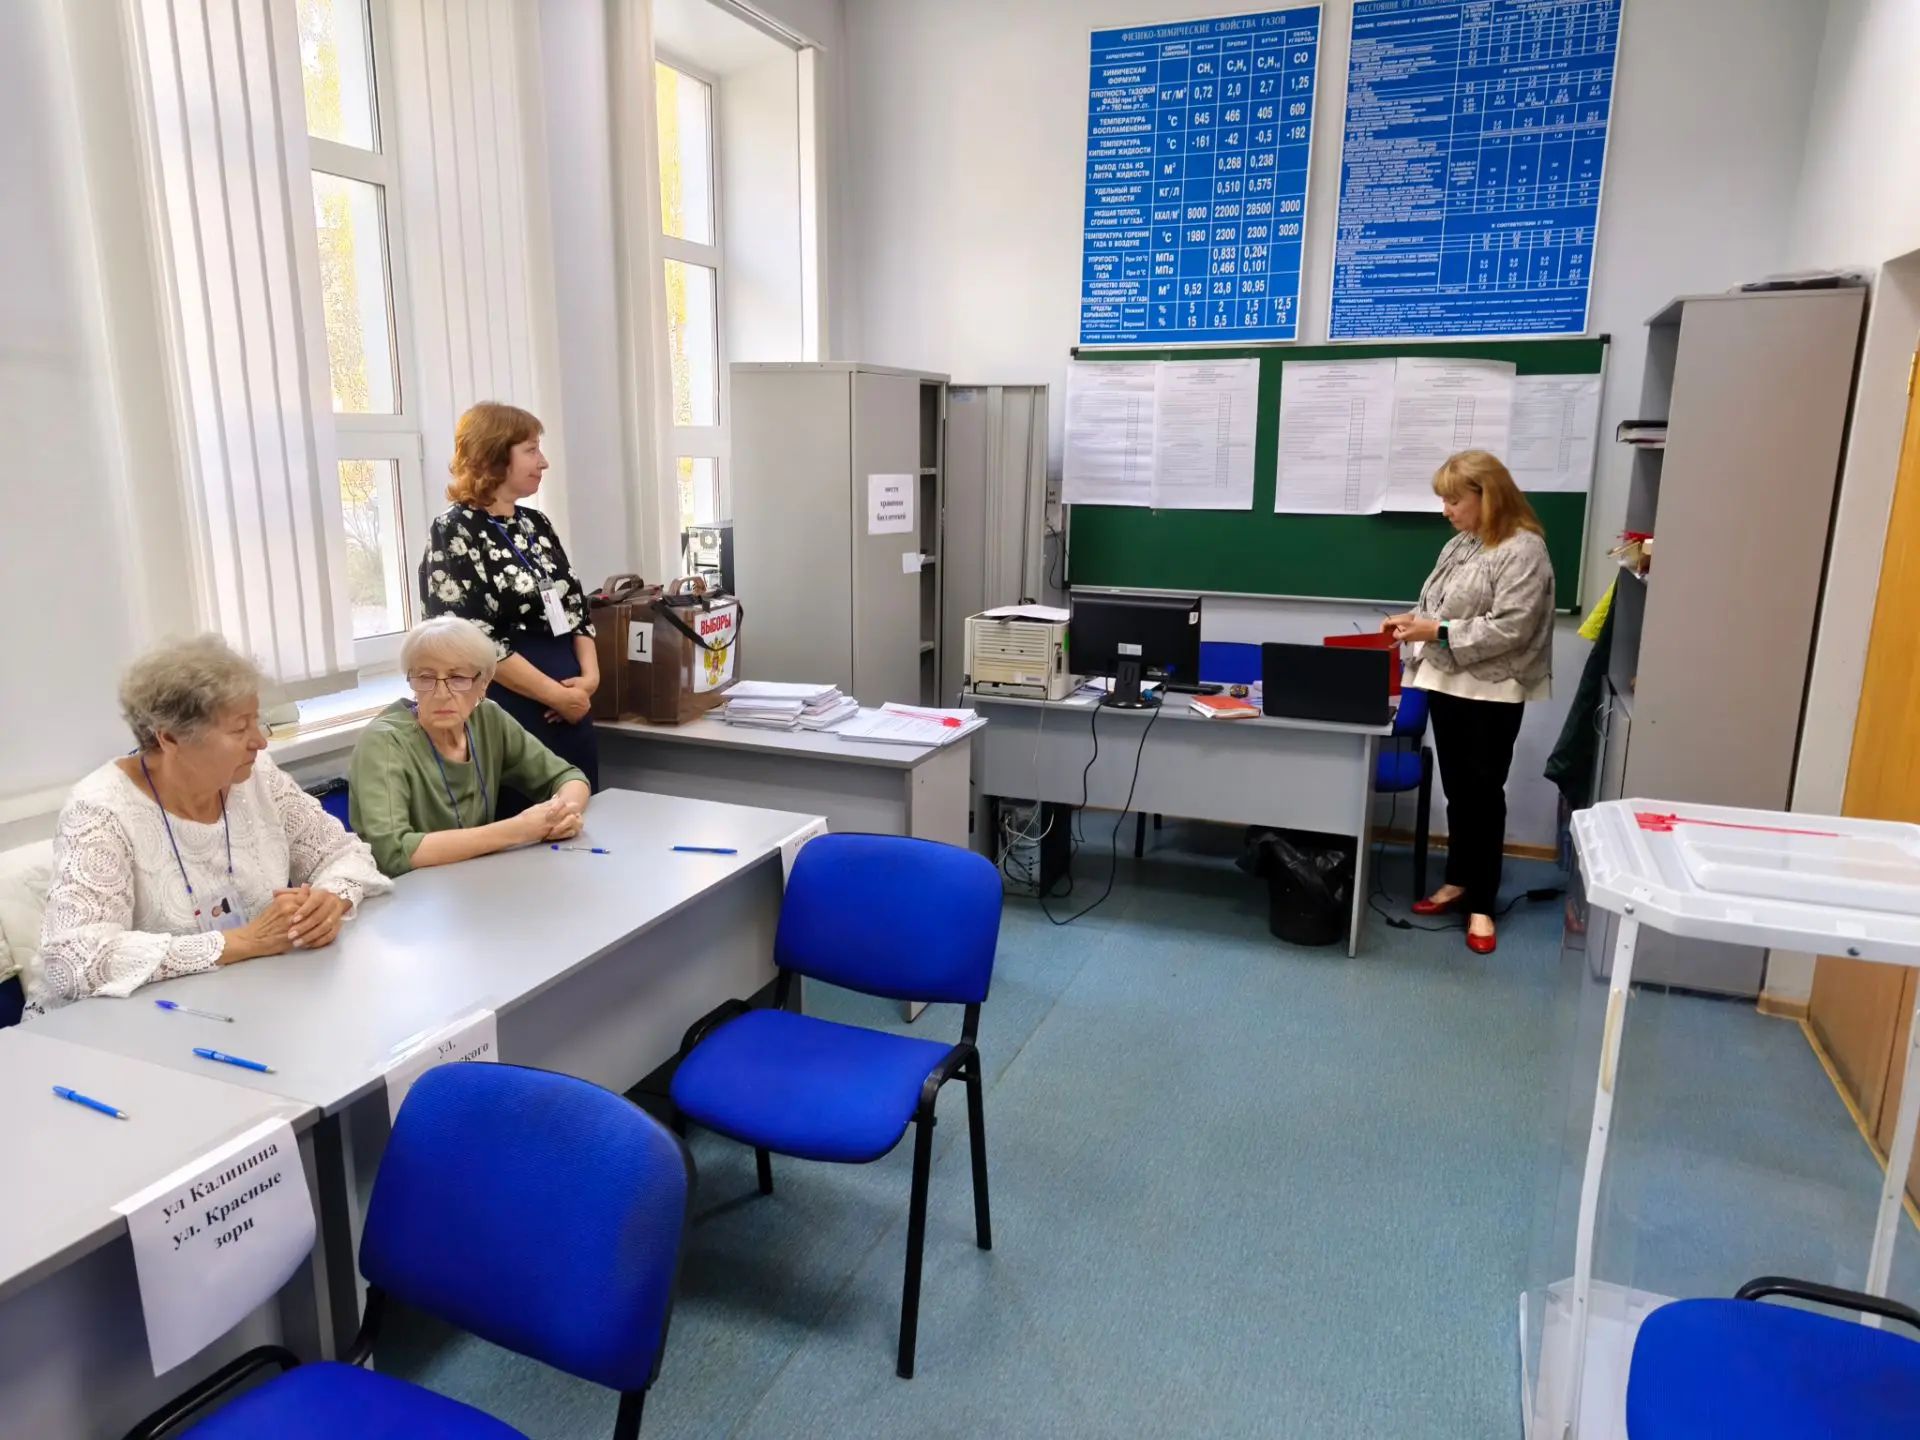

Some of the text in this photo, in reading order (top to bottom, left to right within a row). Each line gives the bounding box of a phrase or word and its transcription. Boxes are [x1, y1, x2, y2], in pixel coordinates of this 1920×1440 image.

[1121, 15, 1287, 42] ФИЗИКО-ХИМИЧЕСКИЕ СВОЙСТВА ГАЗОВ
[1103, 66, 1147, 77] ХИМИЧЕСКАЯ
[1108, 75, 1141, 85] ФОРМУЛА
[1291, 76, 1309, 91] 1,25
[1091, 86, 1156, 98] ПЛОТНОСТЬ ГАЗОВОЙ
[1194, 85, 1213, 101] 0,72
[1227, 82, 1241, 98] 2,0
[1260, 80, 1274, 94] 2,7
[1257, 106, 1273, 119] 405
[1290, 102, 1306, 116] 609
[1100, 116, 1146, 126] ТЕМПЕРАТУРА
[1194, 112, 1210, 125] 645
[1093, 124, 1152, 135] ВОСПЛАМЕНЕНИЯ
[1286, 126, 1306, 140] -192
[1100, 138, 1140, 148] ТЕМПЕРАТУРА
[1191, 135, 1210, 148] -161
[1225, 132, 1239, 145] -42
[1255, 130, 1272, 144] -0,5
[1088, 147, 1151, 157] КИПЕНИЯ ЖИДКОСТИ
[1218, 156, 1241, 171] 0,268
[1250, 154, 1274, 168] 0,238
[1116, 170, 1150, 179] ЖИДКОСТИ
[1094, 185, 1128, 195] УДЕЛЬНЫЙ
[1217, 180, 1240, 195] 0,510
[1248, 178, 1272, 192] 0,575
[1101, 195, 1135, 203] ЖИДКОСТИ
[1159, 187, 1180, 199] КГ/Л
[1187, 207, 1207, 219] 8000
[1215, 204, 1239, 218] 22000
[1246, 202, 1271, 215] 28500
[1280, 200, 1300, 213] 3000
[1187, 230, 1206, 242] 1980
[1216, 228, 1235, 241] 2300
[1247, 226, 1267, 239] 2300
[1279, 223, 1299, 236] 3020
[1155, 253, 1174, 262] МПа
[1213, 247, 1236, 260] 0,833
[1244, 245, 1267, 259] 0,204
[1155, 265, 1174, 275] МПа
[1243, 260, 1265, 274] 0,101
[1184, 283, 1202, 296] 9,52
[1213, 282, 1231, 295] 23,8
[1242, 280, 1265, 293] 30,95
[1190, 302, 1195, 313] 5
[1219, 301, 1224, 312] 2
[1246, 300, 1259, 312] 1,5
[1274, 298, 1291, 310] 12,5
[1187, 316, 1197, 327] 15
[1214, 314, 1227, 327] 9,5
[1244, 313, 1258, 327] 8,5
[1276, 312, 1286, 324] 75
[700, 613, 732, 636] ВЫБОРЫ
[636, 631, 647, 654] 1
[438, 1040, 456, 1060] ул.
[163, 1143, 279, 1224] ул Калинина
[172, 1172, 282, 1251] ул. Красные
[214, 1217, 255, 1249] зори
